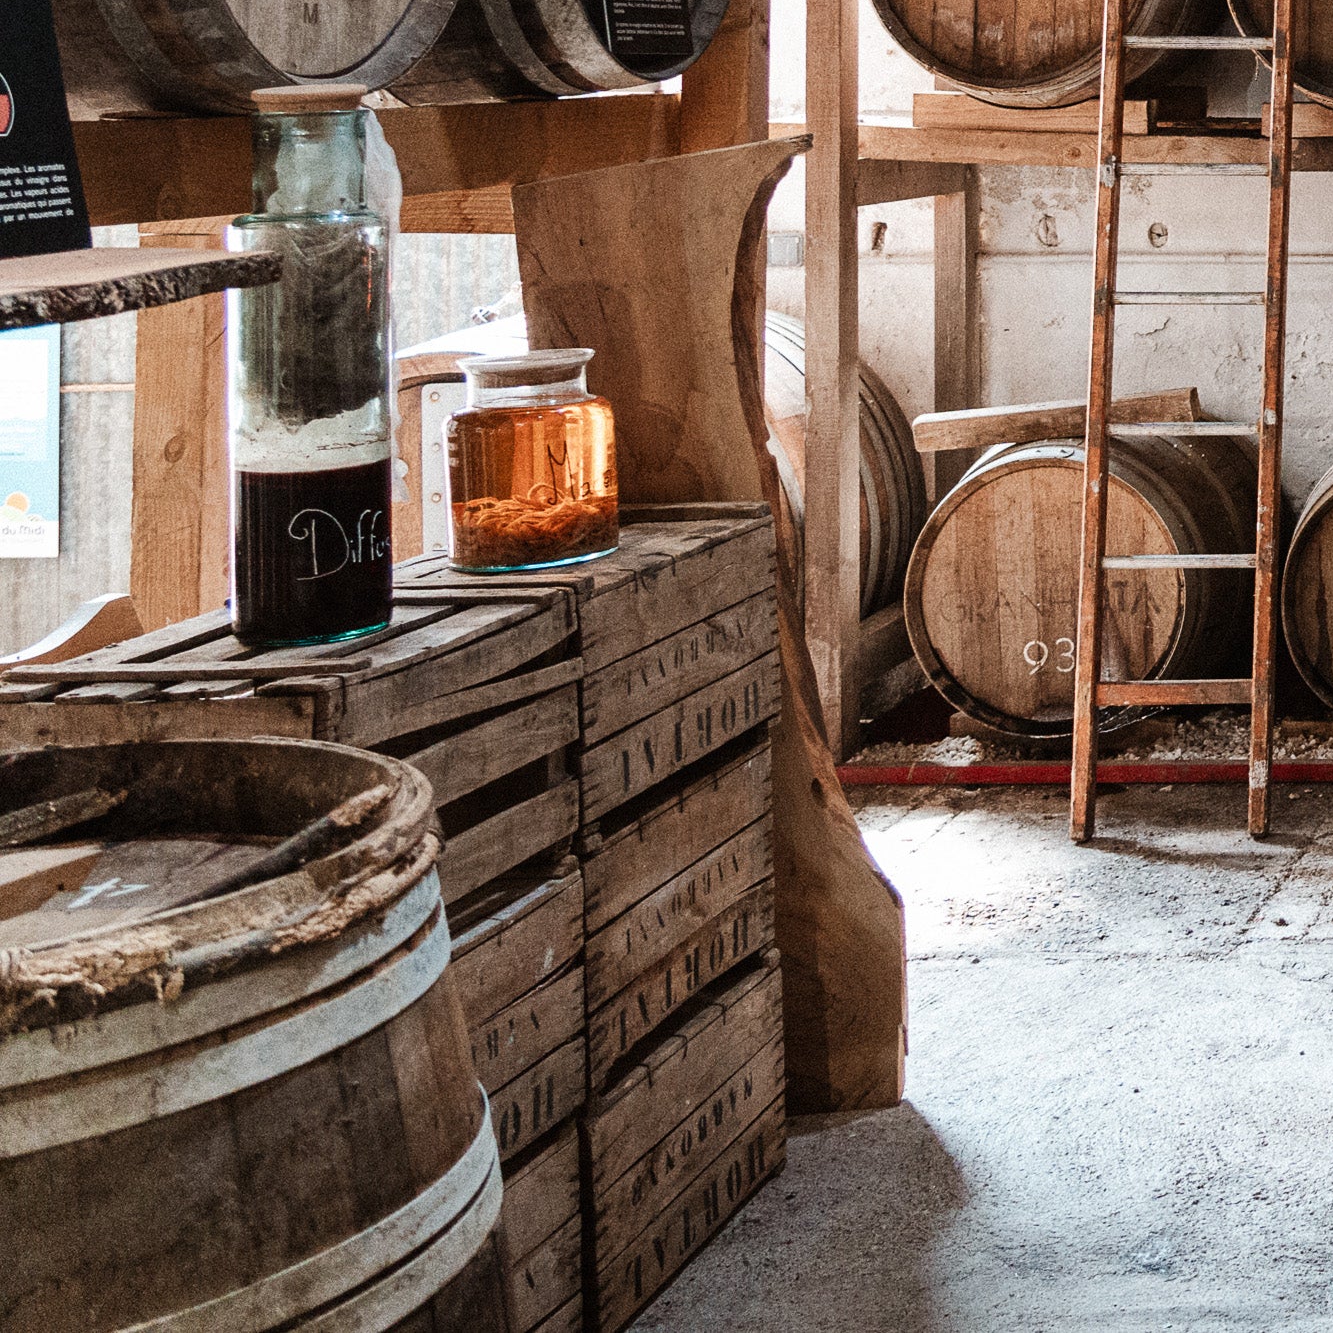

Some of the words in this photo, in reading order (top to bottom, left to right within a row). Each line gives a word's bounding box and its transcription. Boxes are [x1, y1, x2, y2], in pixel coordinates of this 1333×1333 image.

[303, 3, 318, 25] M
[941, 579, 1162, 623] GRANHTA
[1023, 637, 1075, 676] 93
